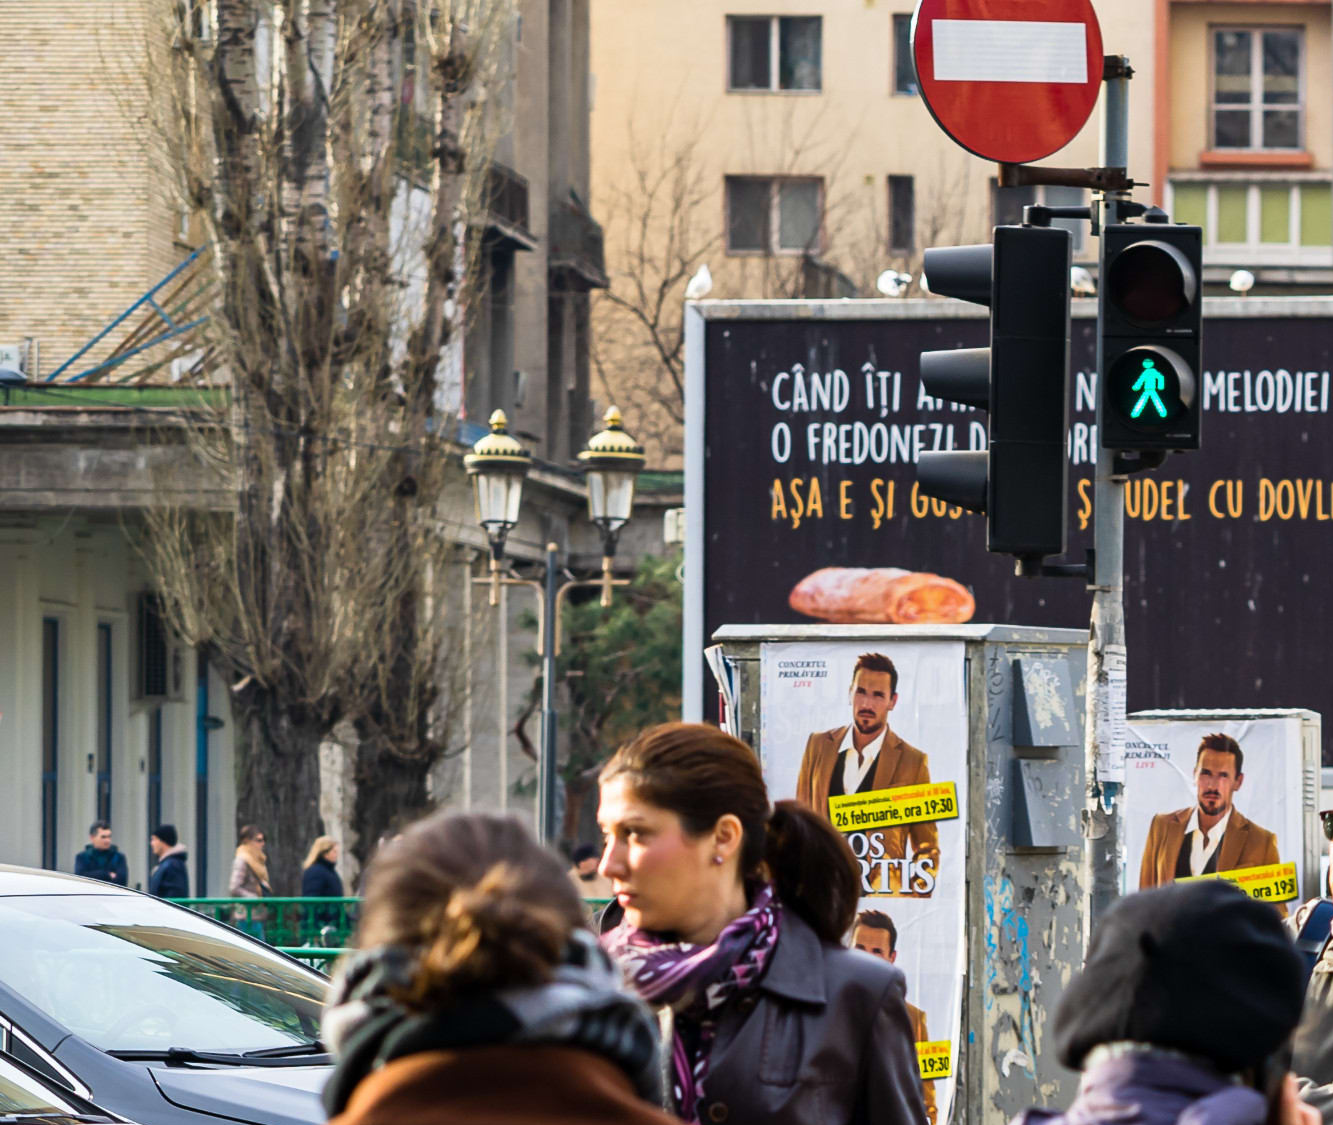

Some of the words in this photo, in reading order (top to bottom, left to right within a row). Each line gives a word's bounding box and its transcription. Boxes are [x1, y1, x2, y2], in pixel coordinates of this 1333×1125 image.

[771, 363, 850, 412] CÂND
[1203, 370, 1330, 413] MELODIEI
[771, 422, 792, 464] O
[840, 480, 854, 520] E
[1208, 479, 1244, 519] CU
[778, 660, 827, 669] CONCERTUL
[793, 680, 813, 688] LIVE
[835, 812, 849, 827] 26
[850, 805, 903, 825] februarie,
[904, 806, 922, 818] ora
[924, 798, 954, 816] 19:30
[1253, 886, 1271, 898] ora
[922, 1056, 950, 1073] 19:30
